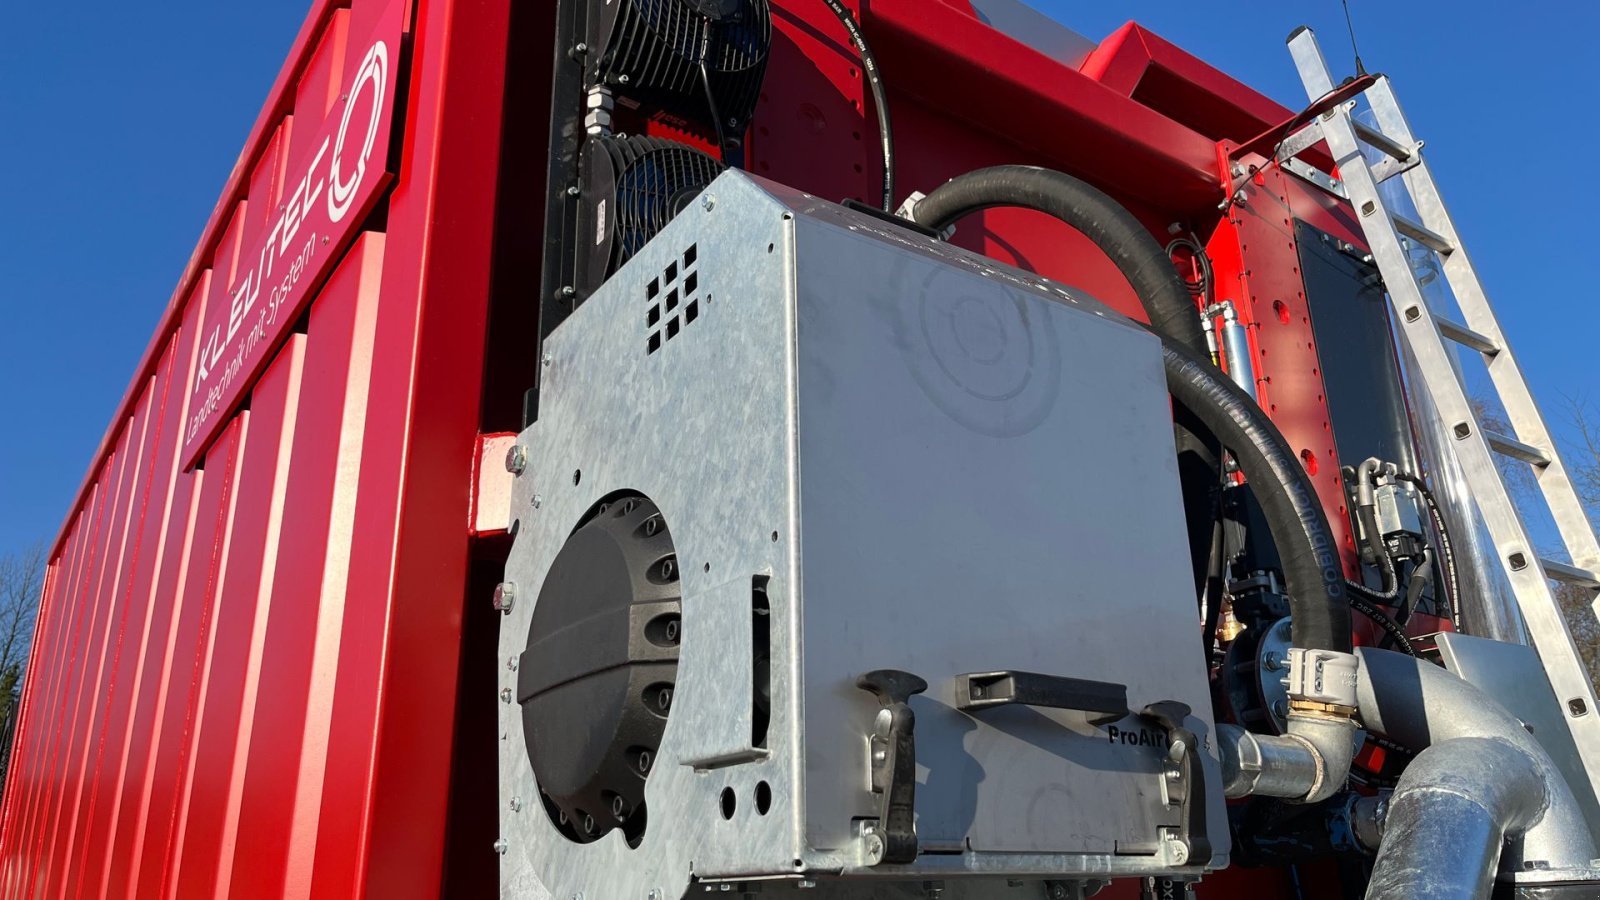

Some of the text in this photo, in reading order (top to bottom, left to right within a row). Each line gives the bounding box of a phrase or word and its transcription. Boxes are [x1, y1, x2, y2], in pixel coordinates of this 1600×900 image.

[186, 232, 316, 446] Landtechnik mit System
[195, 134, 330, 393] KLEUTEC
[1293, 480, 1341, 597] COBIDRUCK
[1108, 725, 1163, 748] ProAir
